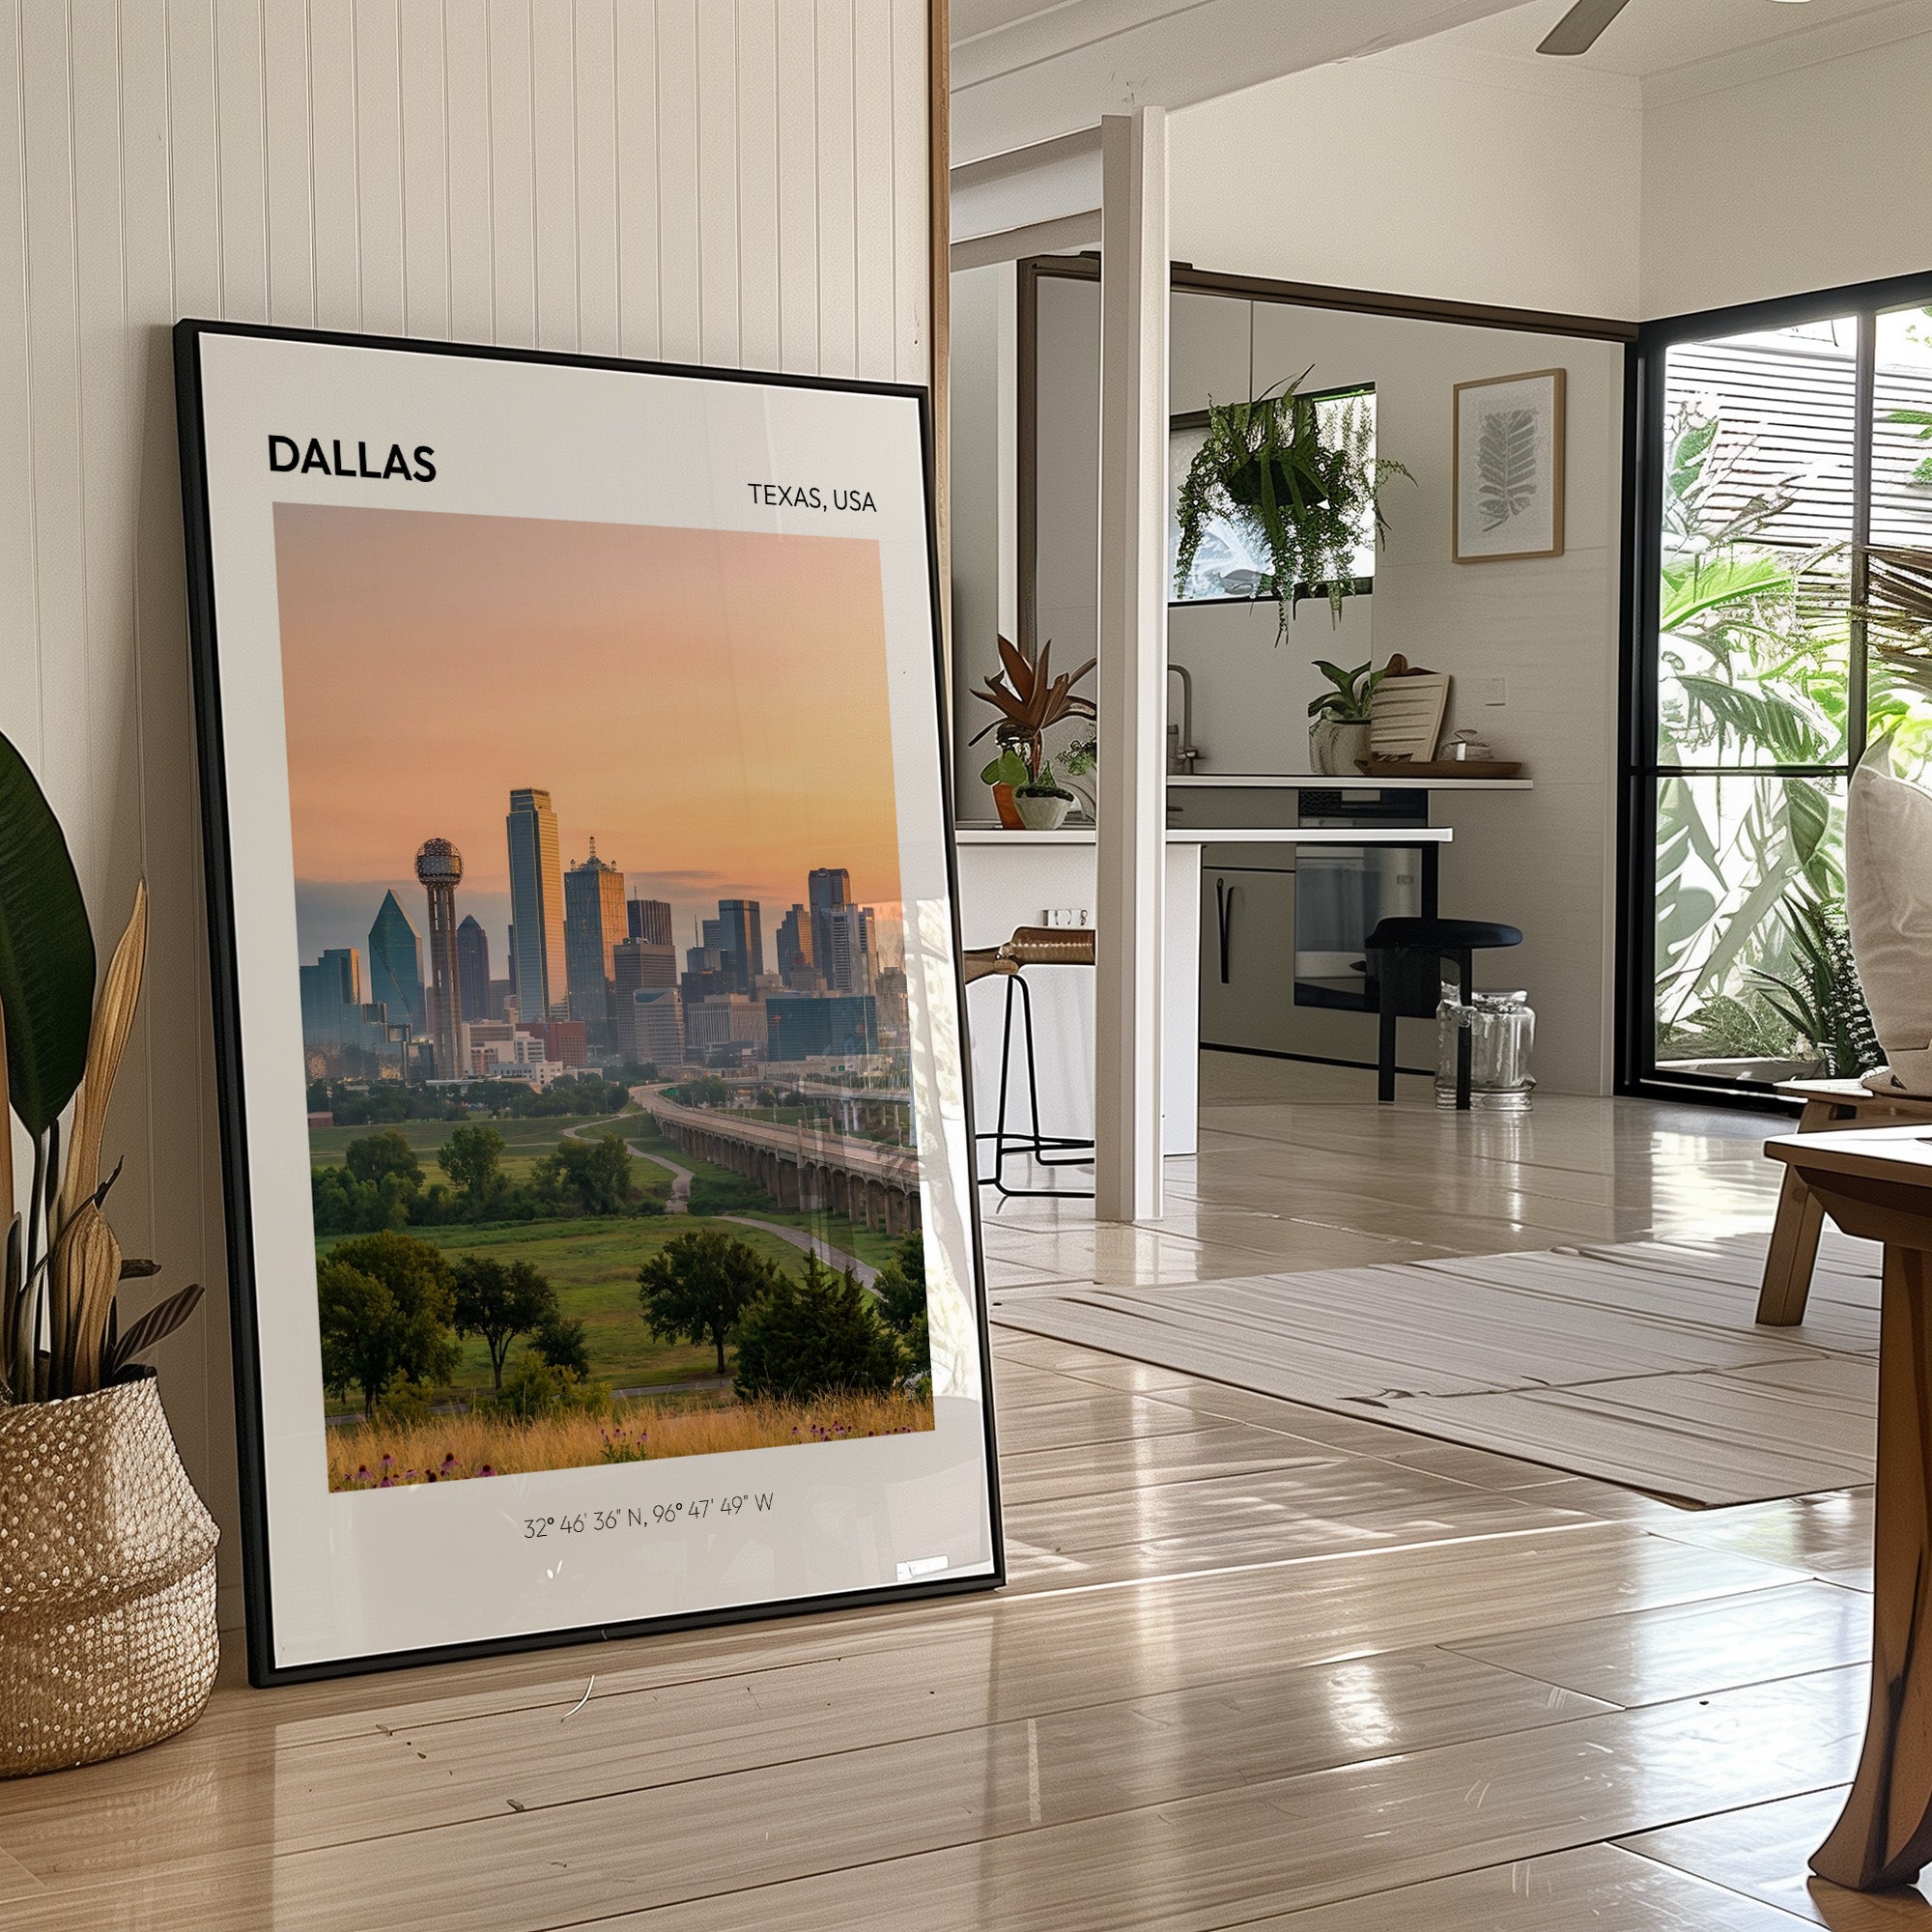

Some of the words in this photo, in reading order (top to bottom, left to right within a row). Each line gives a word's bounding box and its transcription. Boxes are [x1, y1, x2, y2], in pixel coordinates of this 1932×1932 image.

[268, 434, 437, 483] DALLAS
[747, 483, 828, 513] TEXAS,
[833, 489, 877, 513] USA
[628, 1507, 648, 1528] N,
[754, 1492, 774, 1512] W
